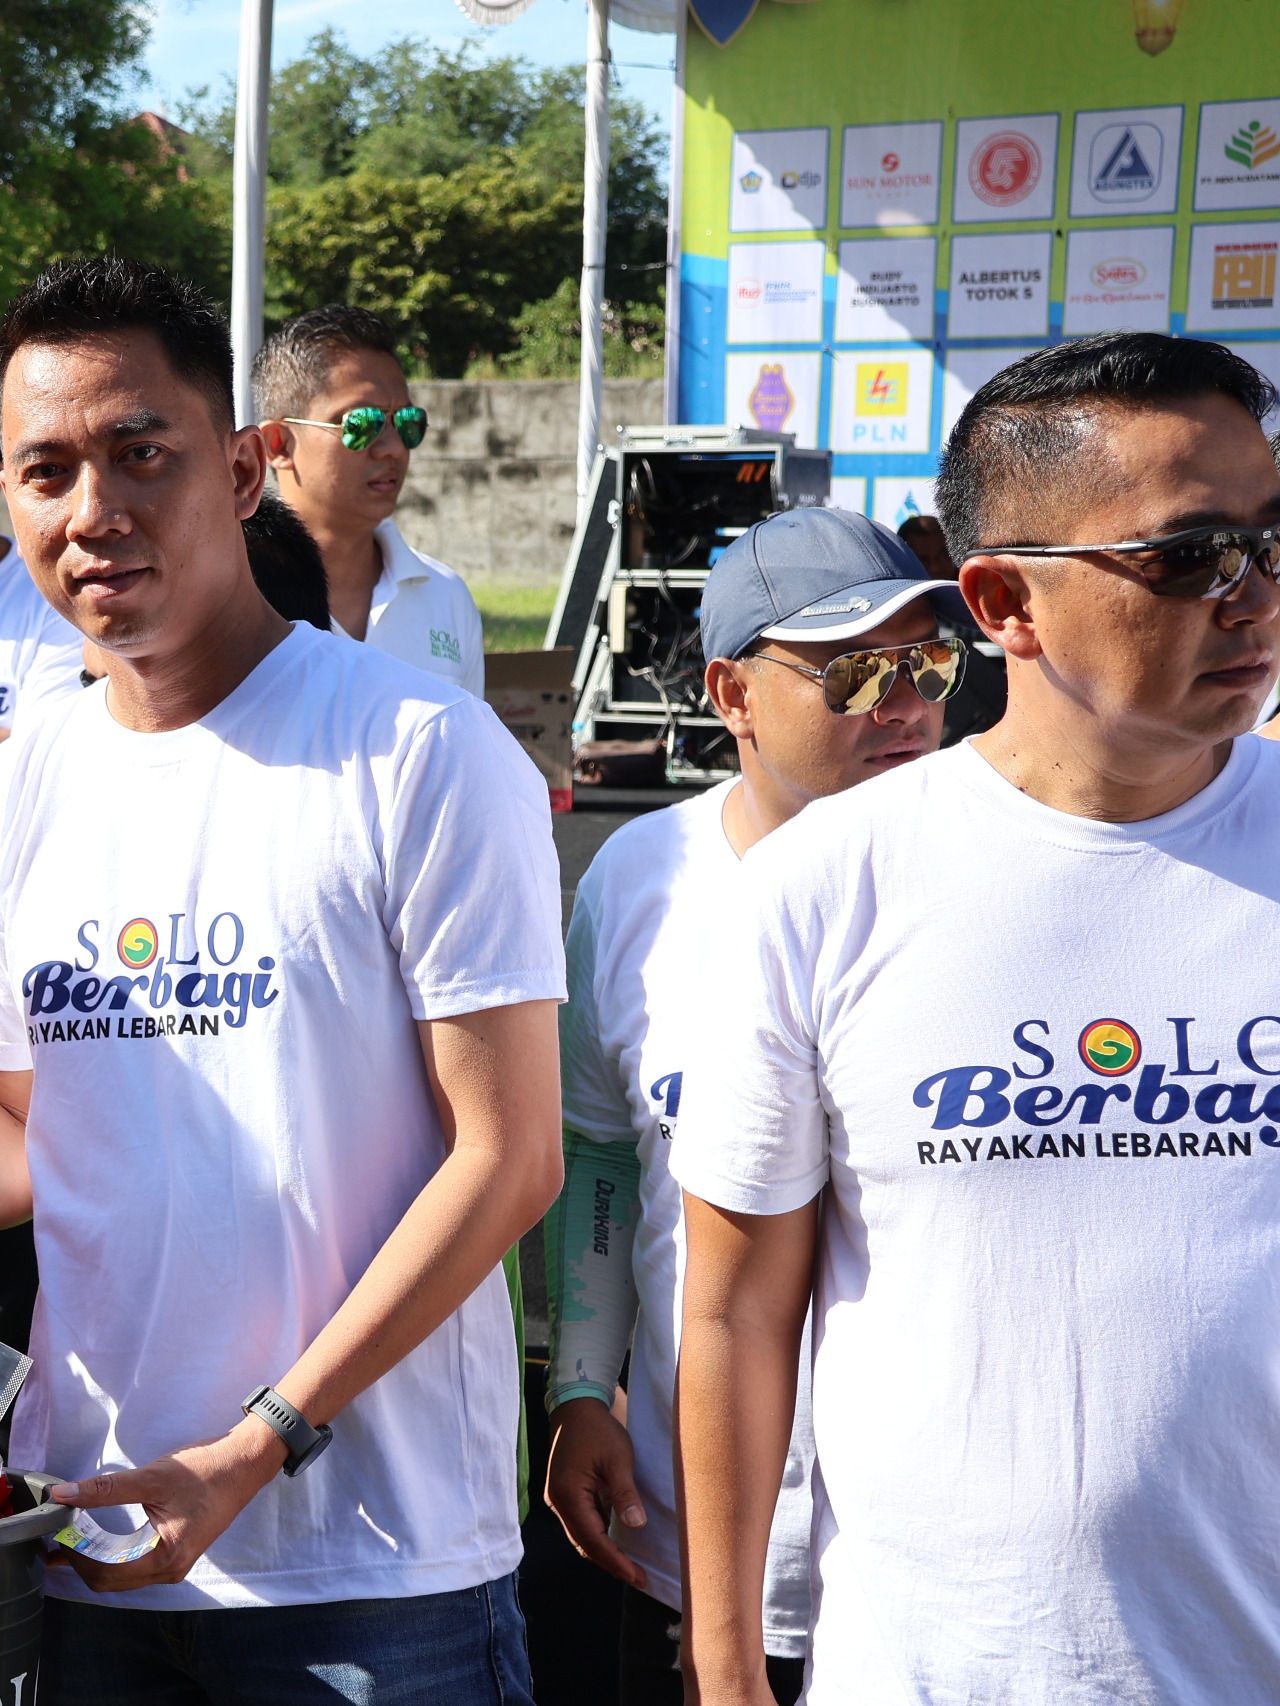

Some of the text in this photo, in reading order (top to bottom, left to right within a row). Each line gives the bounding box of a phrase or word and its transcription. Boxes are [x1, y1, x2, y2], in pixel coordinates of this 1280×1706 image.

[880, 173, 933, 188] MOTOR
[959, 269, 1042, 285] ALBERTUS
[966, 286, 1033, 301] TOTOK S
[853, 424, 907, 442] PLN
[74, 911, 245, 973] SOLO
[22, 956, 280, 1028] Berbagi
[116, 1013, 220, 1039] LEBARAN
[912, 1063, 1280, 1148] Berba
[916, 1131, 1253, 1165] RAYAKAN LEBARAN
